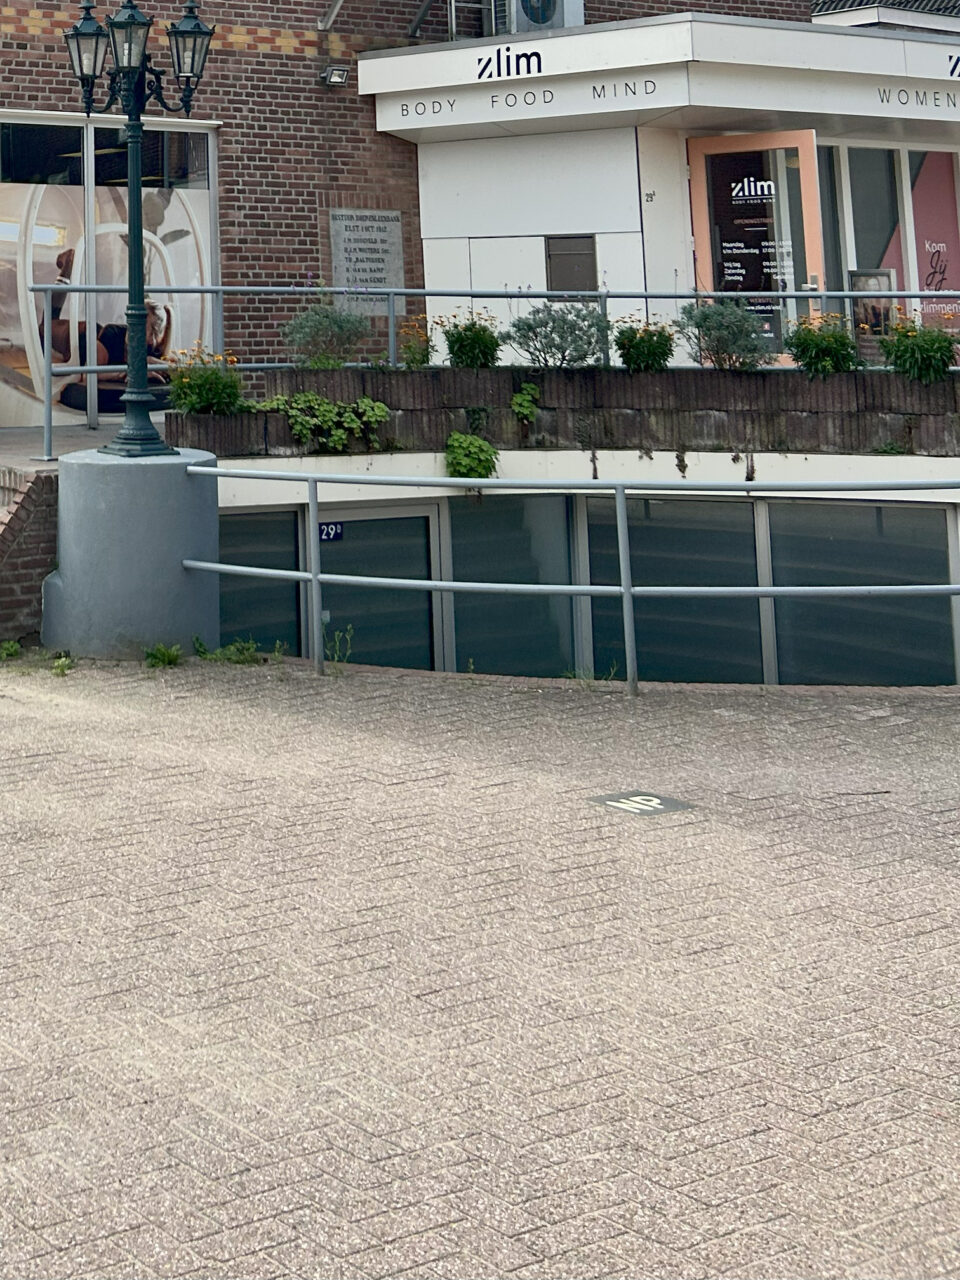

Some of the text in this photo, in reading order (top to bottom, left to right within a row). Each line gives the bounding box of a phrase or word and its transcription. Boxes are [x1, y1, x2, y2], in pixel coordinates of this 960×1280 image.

[477, 46, 542, 80] zlim
[401, 80, 657, 117] BODY FOOD MIND
[877, 87, 957, 108] WOMEN
[730, 176, 776, 197] zlim
[925, 240, 947, 252] Kom
[605, 795, 665, 813] NP
